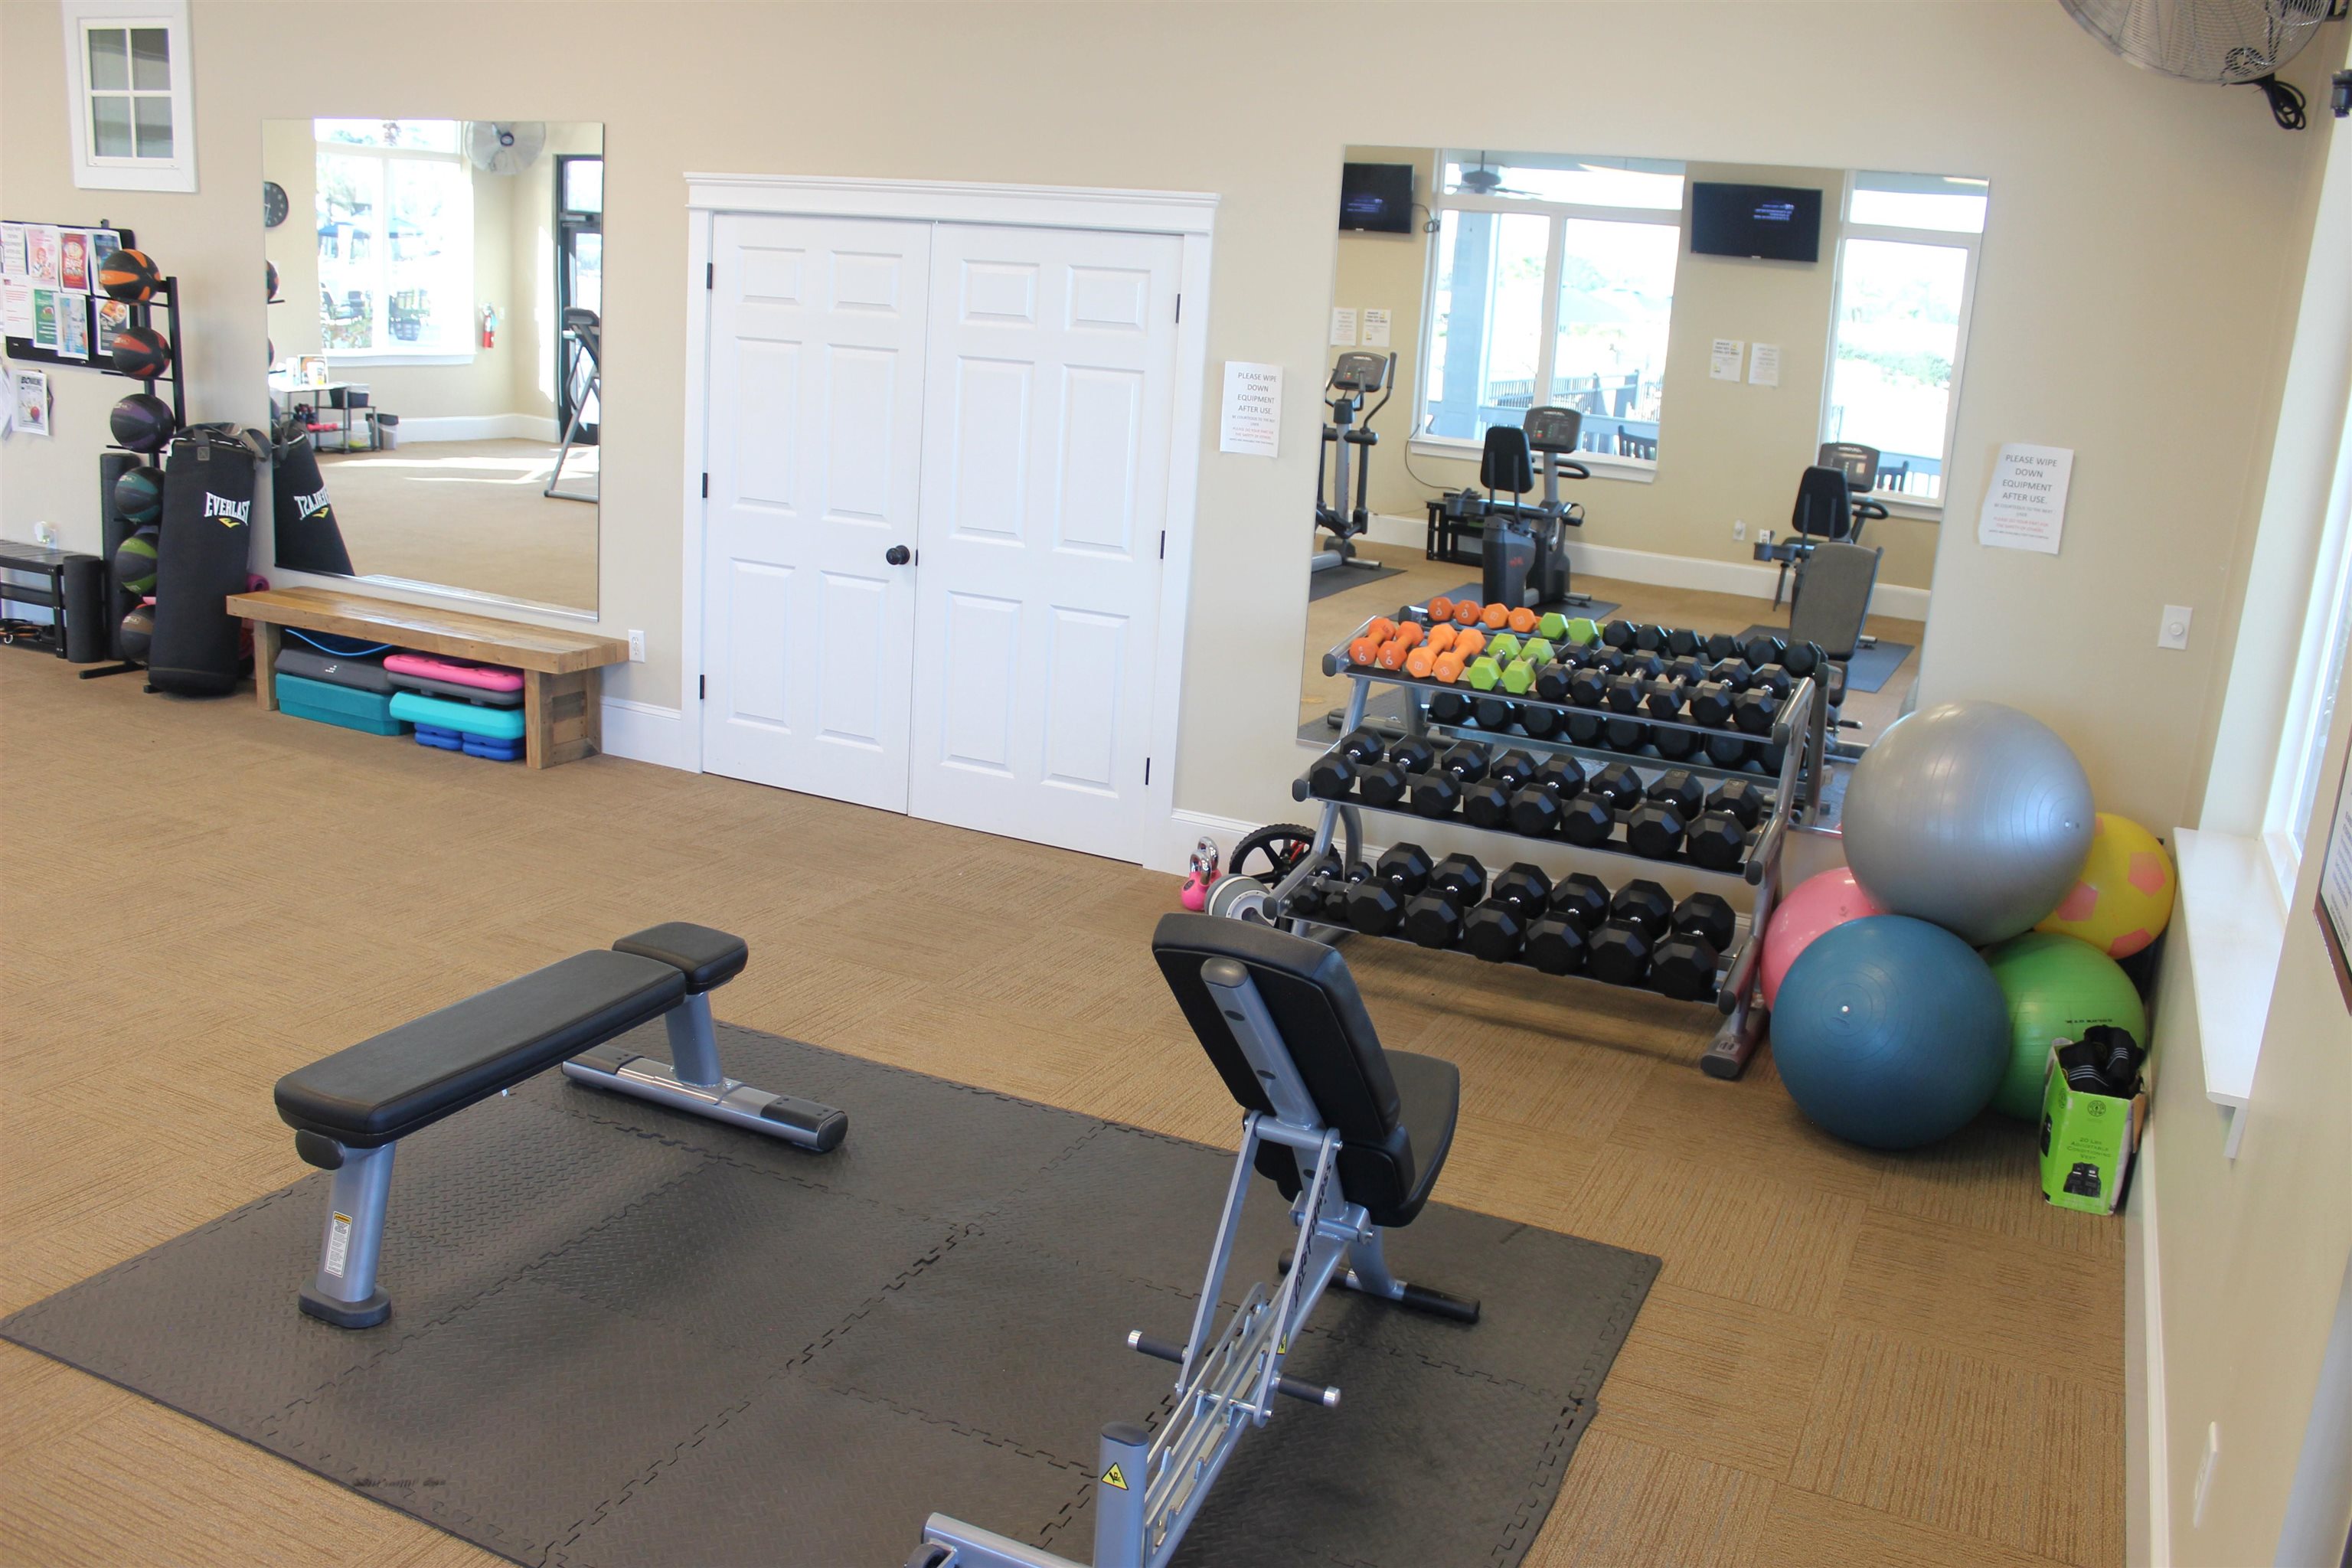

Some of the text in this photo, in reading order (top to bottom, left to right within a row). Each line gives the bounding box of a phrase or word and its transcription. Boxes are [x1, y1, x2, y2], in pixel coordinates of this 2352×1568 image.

[1238, 372, 1261, 381] PLEASE
[1247, 384, 1269, 392] DOWN
[1237, 394, 1275, 403] EQUIPMENT
[1238, 405, 1259, 413] AFTER
[2005, 454, 2057, 466] PLEASE WIPE
[2015, 468, 2043, 478] DOWN
[2003, 479, 2052, 491] EQUIPMENT
[2003, 492, 2047, 504] AFTER USE.
[204, 492, 250, 526] EVERLAST
[1359, 652, 1367, 662] 6
[1386, 656, 1393, 665] 6
